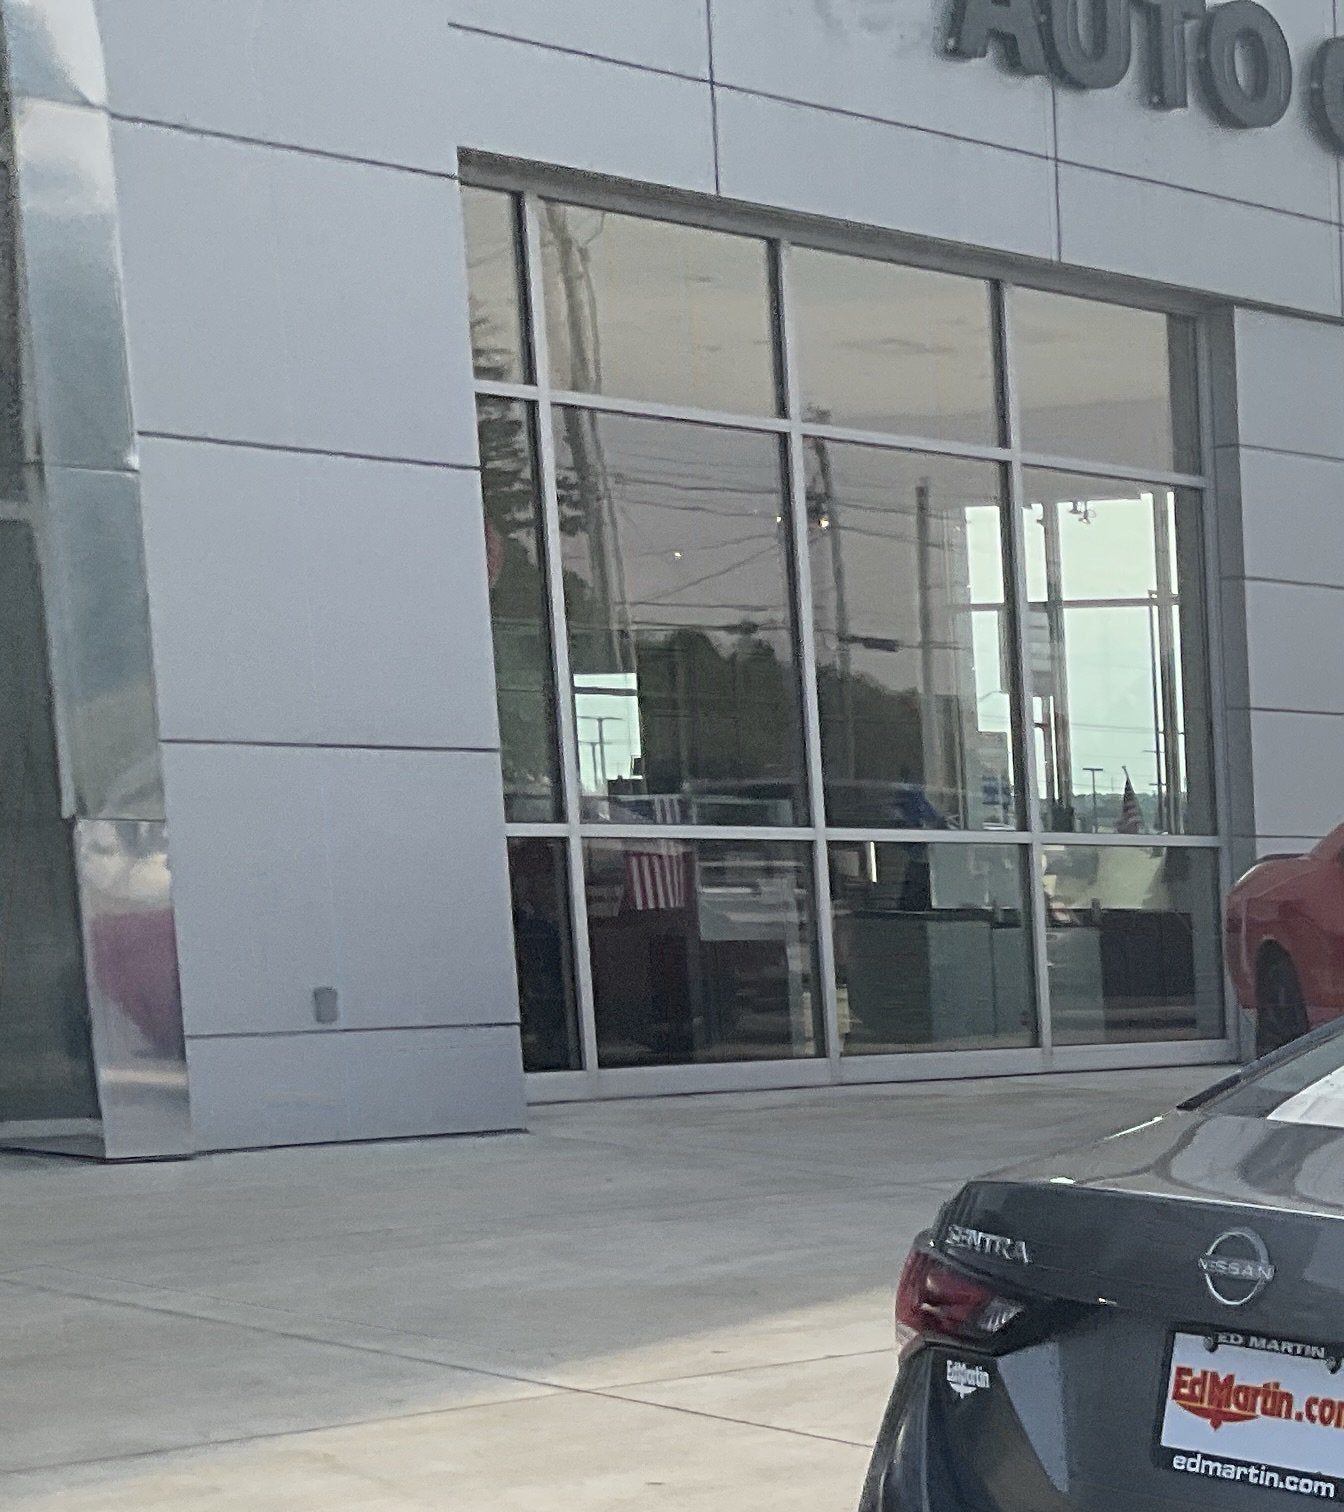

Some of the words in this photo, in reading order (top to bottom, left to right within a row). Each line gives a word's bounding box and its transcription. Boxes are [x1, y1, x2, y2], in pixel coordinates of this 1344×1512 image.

[936, 0, 1292, 129] AUTO
[945, 1224, 1030, 1263] SENTRA
[1199, 1258, 1274, 1280] NISSAN
[1217, 1332, 1244, 1345] ED
[1249, 1336, 1325, 1359] MARTIN
[1172, 1454, 1335, 1498] edmartin.com
